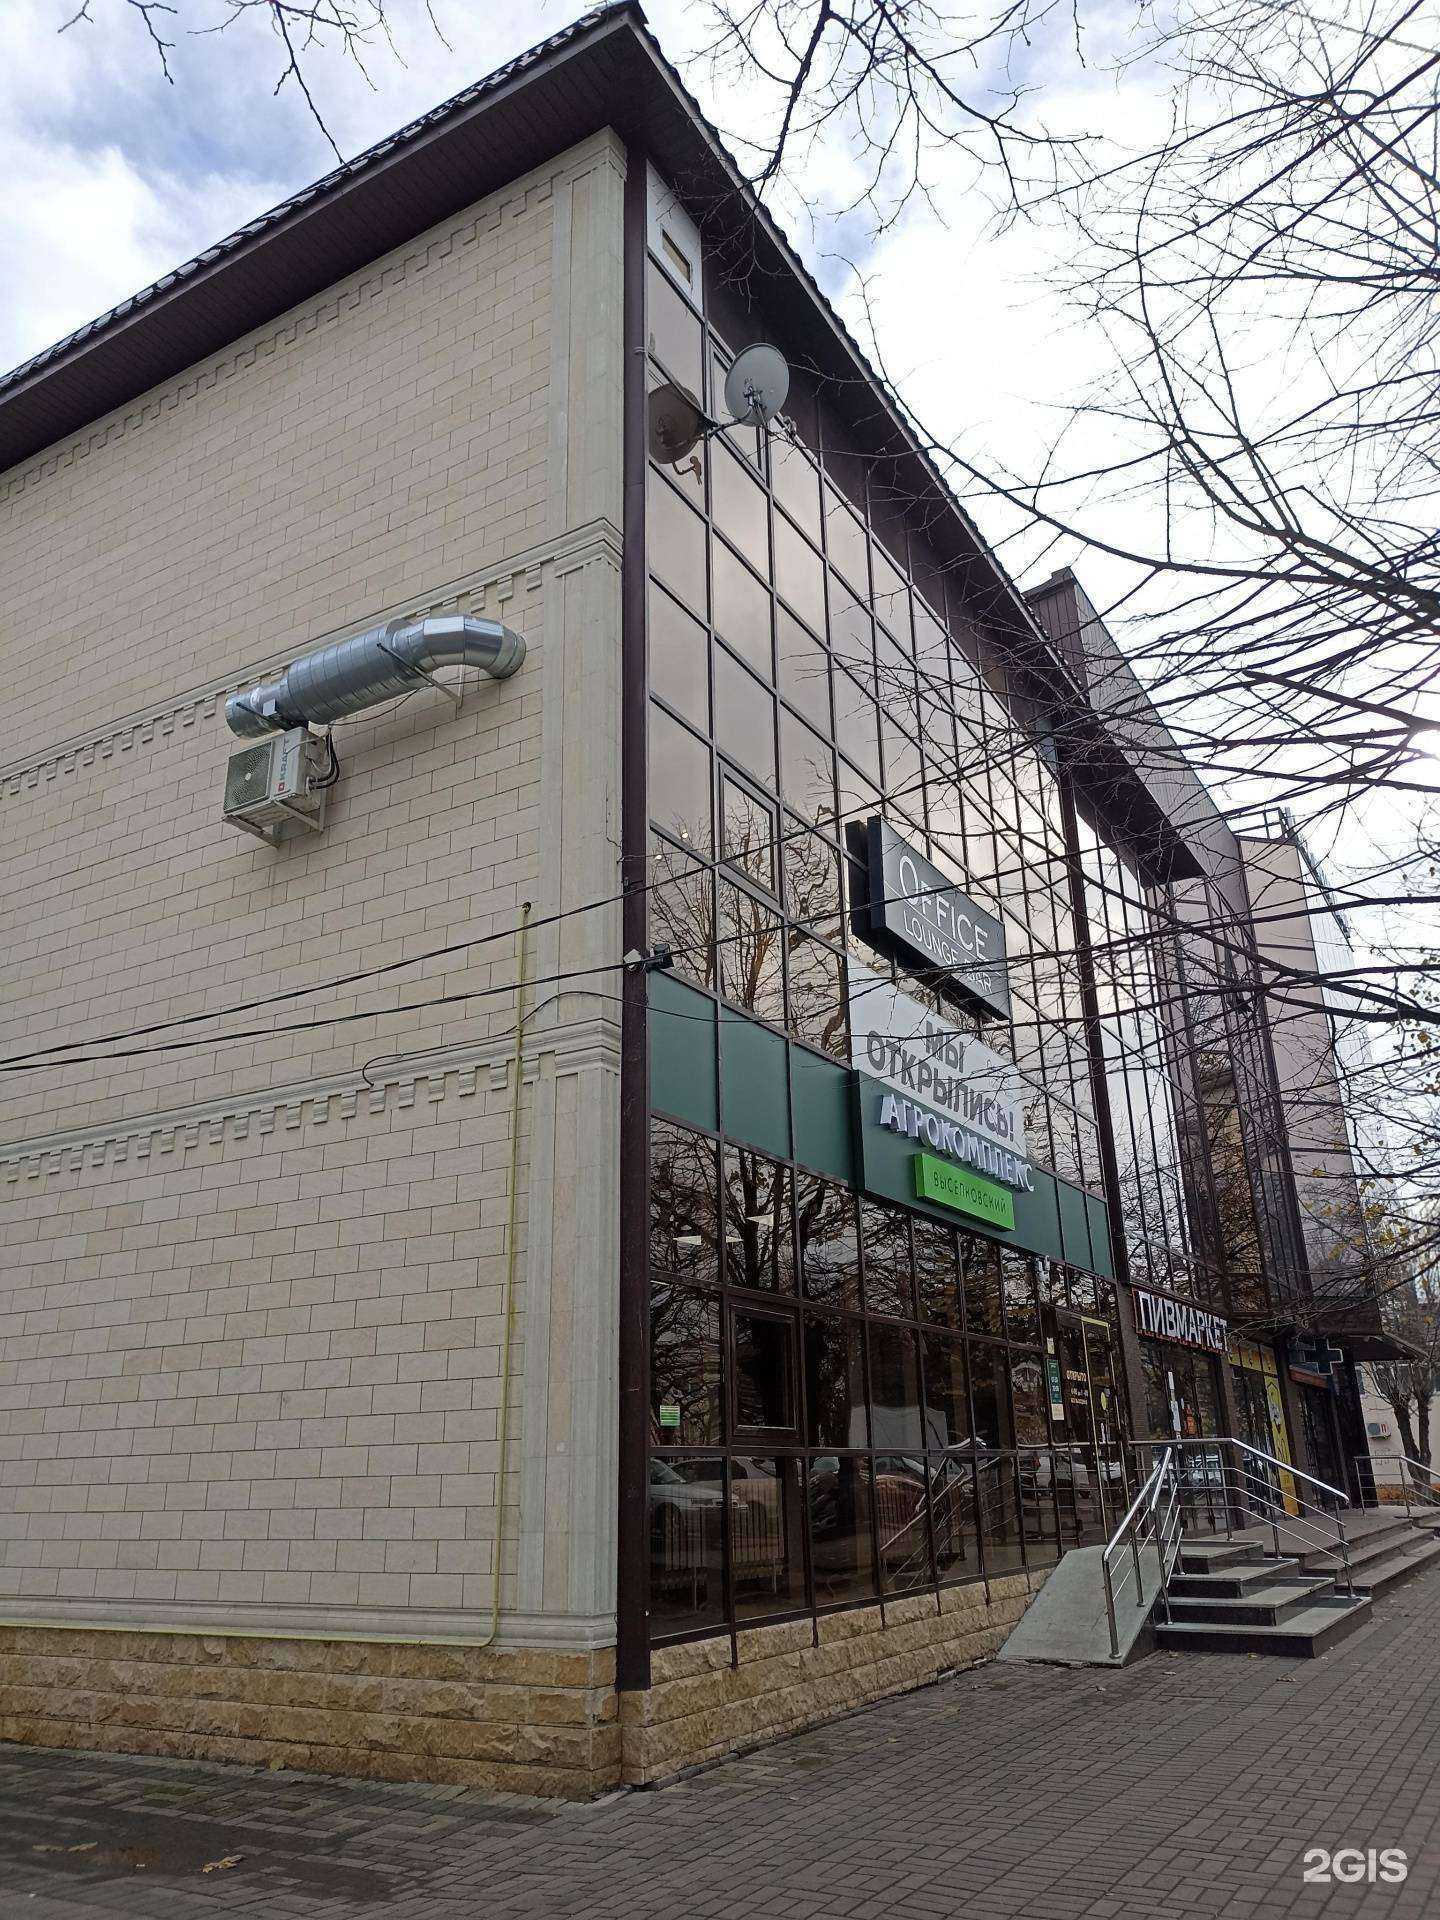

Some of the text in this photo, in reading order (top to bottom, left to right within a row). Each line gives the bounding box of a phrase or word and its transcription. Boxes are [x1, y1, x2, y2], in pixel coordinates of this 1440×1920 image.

[899, 855, 989, 963] OFFICE
[903, 909, 959, 970] LOUNGE
[925, 1020, 965, 1073] МЫ
[866, 1030, 1014, 1142] ОТКРЫЛИСЬ!
[879, 1093, 1035, 1193] АГРОКОМПЛЕКС
[933, 1171, 1007, 1214] ВЫСЕЛКОВСКИЙ
[1138, 1290, 1229, 1352] ПИВМАРКЕТ
